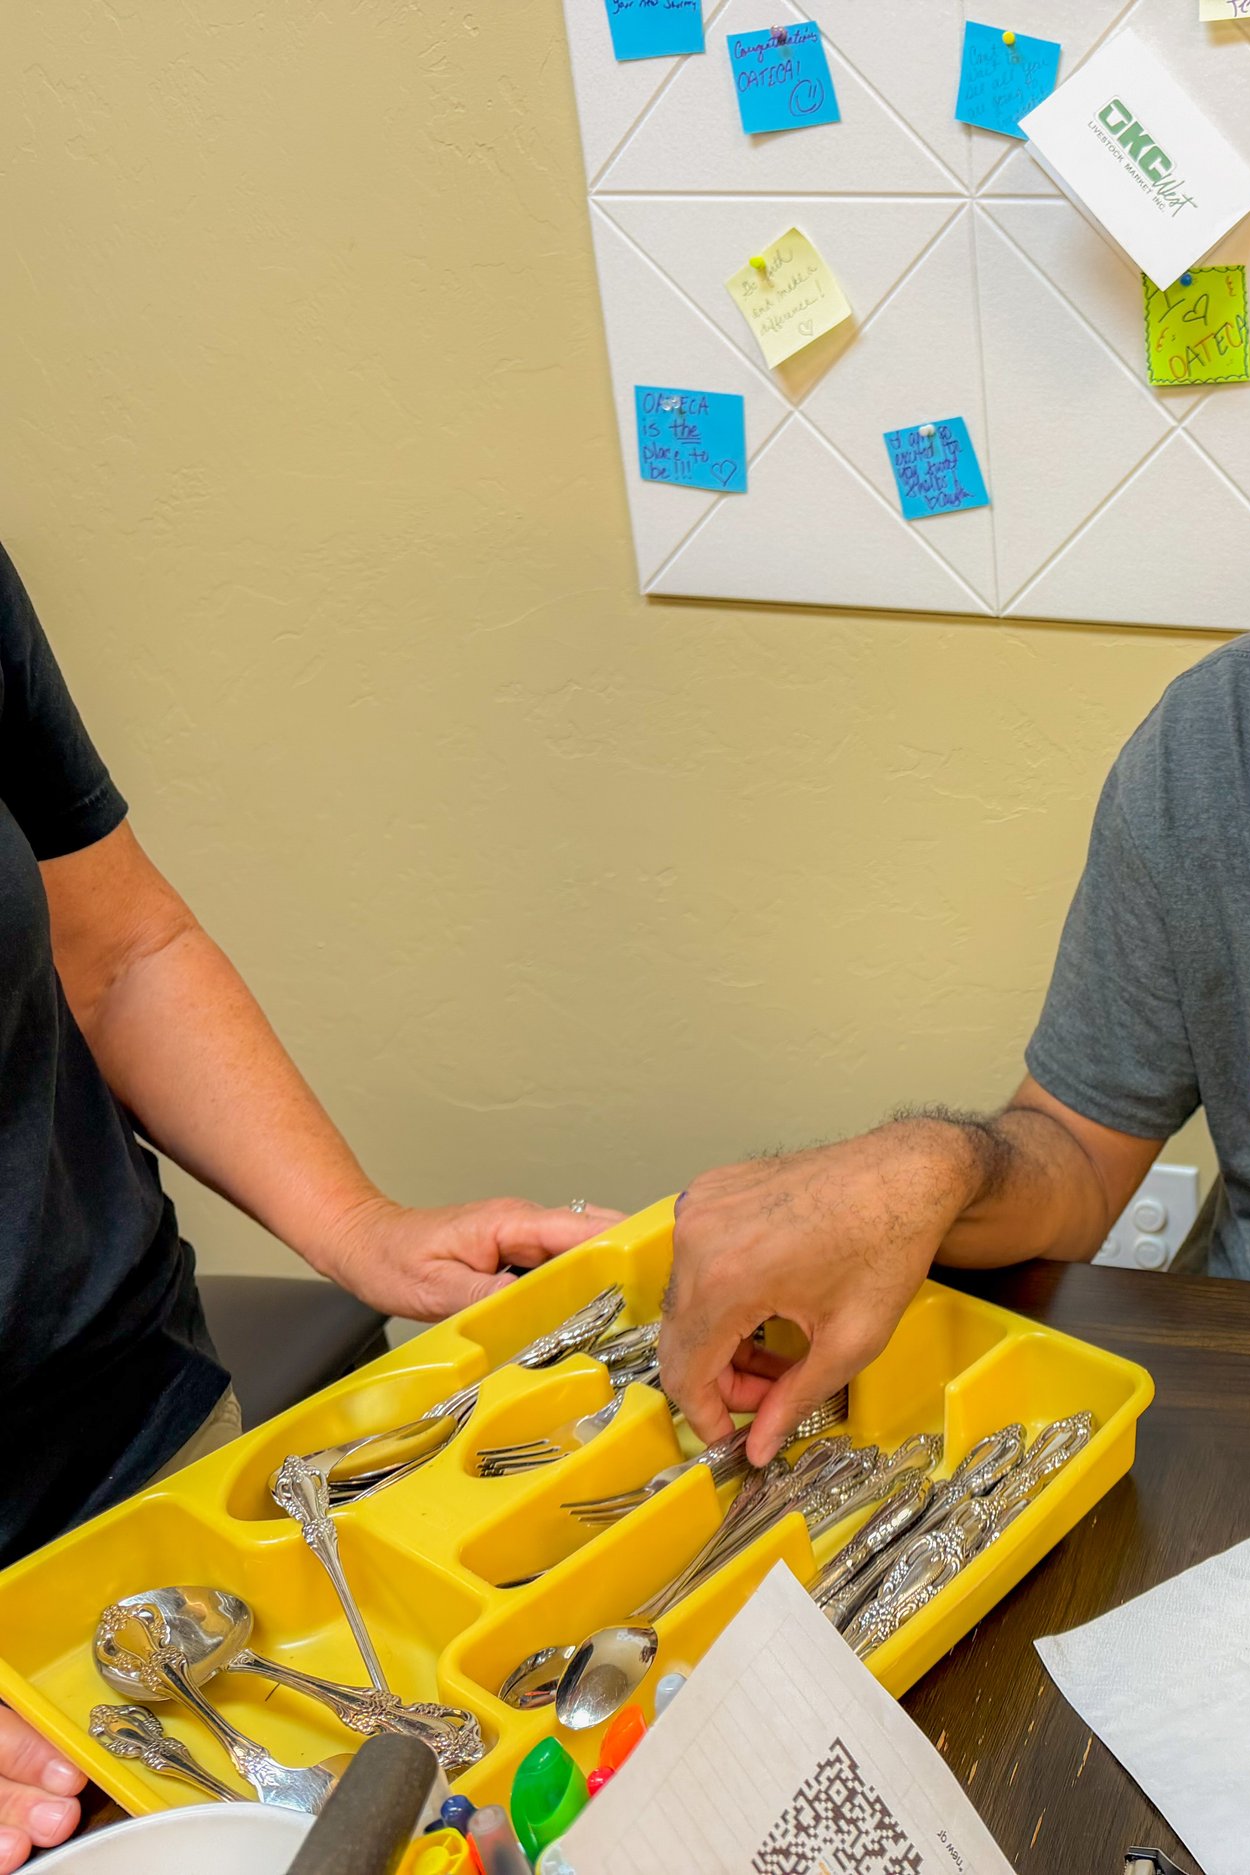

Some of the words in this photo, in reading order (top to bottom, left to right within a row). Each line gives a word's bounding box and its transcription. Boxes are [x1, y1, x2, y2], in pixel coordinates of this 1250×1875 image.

[1087, 120, 1124, 163] LIVESTOCK
[1123, 162, 1153, 195] MARKET
[1098, 98, 1173, 182] OKC
[1151, 172, 1199, 218] West
[642, 418, 661, 438] is
[667, 418, 702, 440] the
[642, 441, 681, 464] place
[688, 447, 709, 464] to
